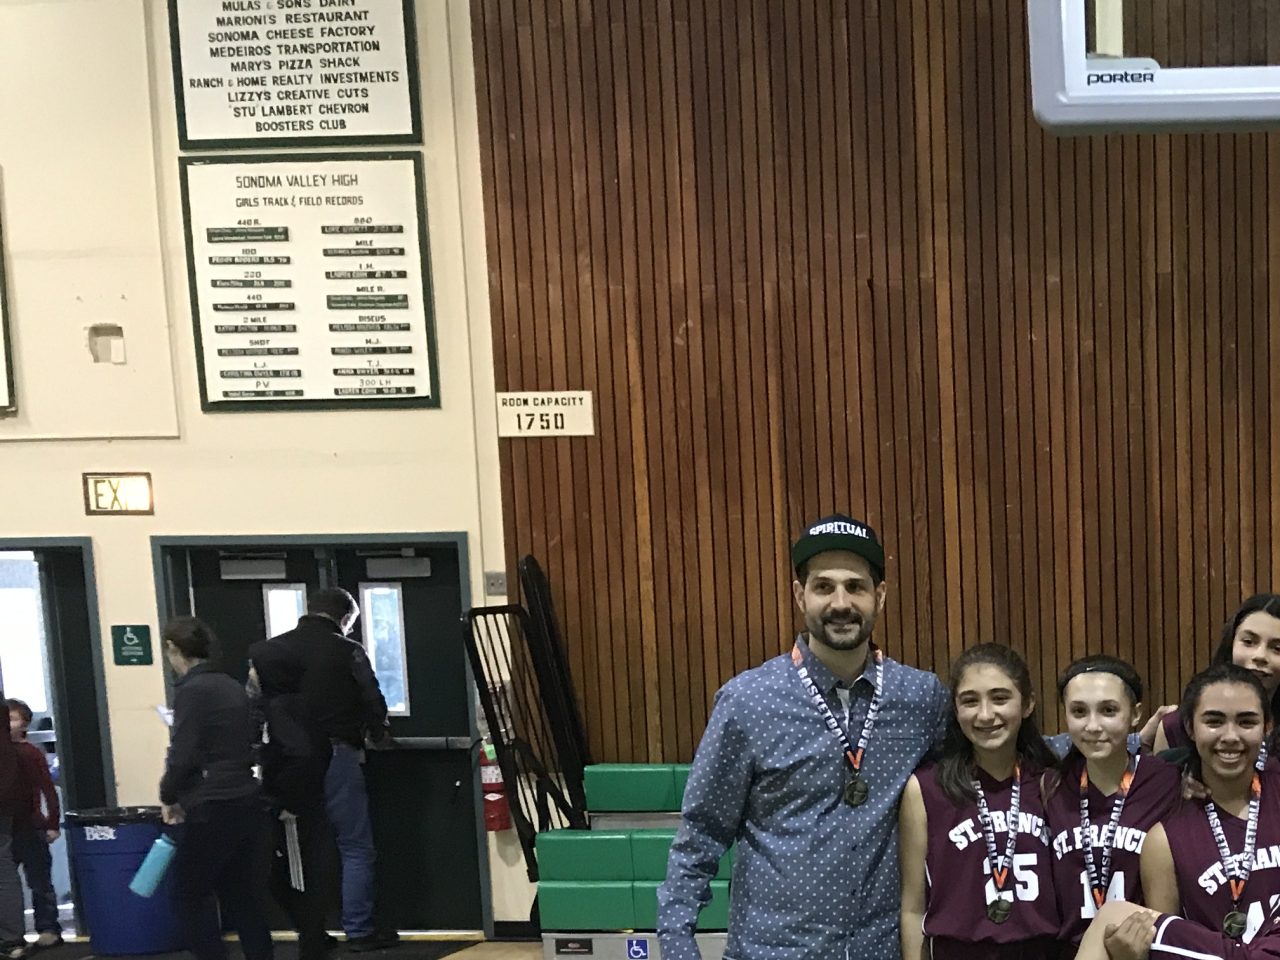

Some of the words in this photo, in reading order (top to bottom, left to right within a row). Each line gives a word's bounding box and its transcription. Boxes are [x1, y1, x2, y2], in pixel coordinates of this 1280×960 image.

[222, 0, 261, 12] MULAS
[285, 10, 369, 24] RESTAURANT
[208, 29, 259, 43] SONOMA
[265, 27, 314, 40] CHEESE
[320, 25, 376, 38] FACTORY
[209, 45, 272, 58] MEDEIROS
[276, 40, 380, 55] TRANSPORTATION
[278, 58, 313, 70] PIZZA
[320, 57, 360, 68] SHACK
[189, 77, 224, 88] RANCH
[236, 76, 267, 87] HOME
[272, 74, 313, 86] REALTY
[320, 71, 399, 84] INVESTMENTS
[277, 89, 330, 101] CREATIVE
[337, 88, 369, 98] CUTS
[261, 104, 313, 117] LAMBERT
[318, 103, 369, 114] CHEVRON
[255, 120, 314, 133] BOOSTERS
[319, 119, 346, 130] CLUB
[235, 175, 283, 188] SONOMA
[286, 174, 327, 187] VALLEY
[331, 174, 358, 186] HIGH
[235, 197, 260, 208] GIRLS
[263, 197, 289, 207] TRACK
[299, 196, 323, 206] FIELD
[325, 195, 364, 206] RECORDS
[502, 398, 529, 407] ROOM
[533, 397, 584, 406] CAPACITY
[516, 413, 565, 430] 1750
[797, 666, 850, 748] BASKETBALL
[949, 818, 983, 851] ST.
[1053, 830, 1073, 860] ST.
